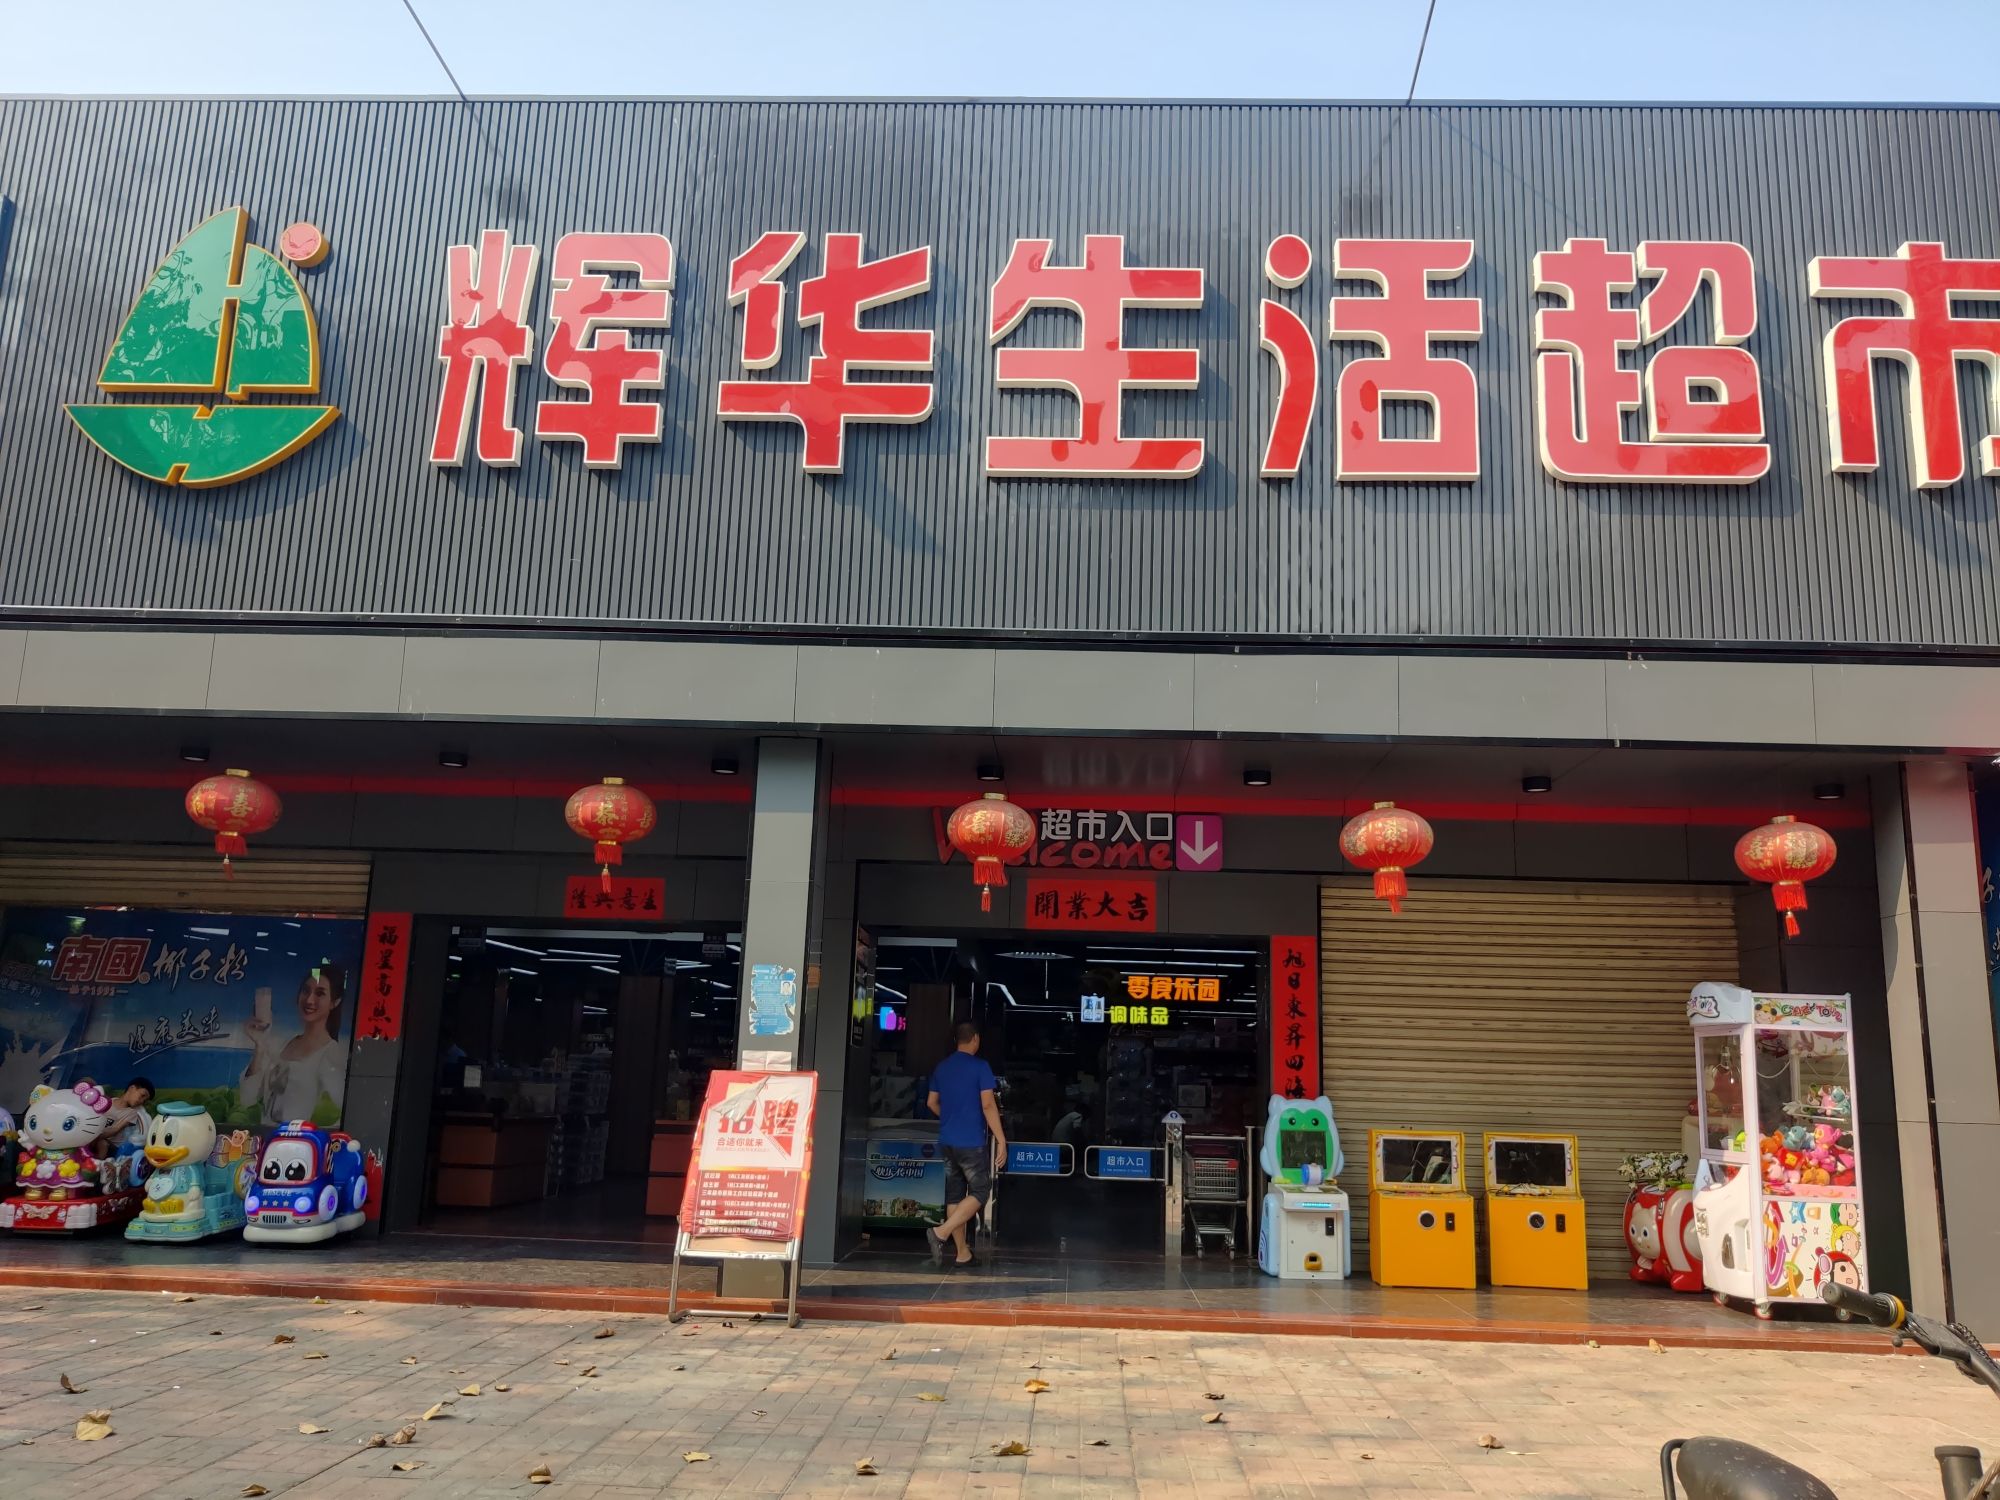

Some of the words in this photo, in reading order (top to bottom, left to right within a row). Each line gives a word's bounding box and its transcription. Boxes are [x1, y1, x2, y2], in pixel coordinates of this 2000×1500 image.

[430, 227, 2000, 491] 辉华生活超市
[931, 807, 1173, 871] Wlcome
[1040, 808, 1173, 842] 超市入口
[1034, 889, 1149, 923] 開業大吉
[51, 934, 152, 983] 南國
[1126, 975, 1221, 1002] 零食乐园
[1110, 1005, 1170, 1026] 调味品
[1016, 1151, 1053, 1162] 超市入口
[1106, 1155, 1144, 1167] 超市入口
